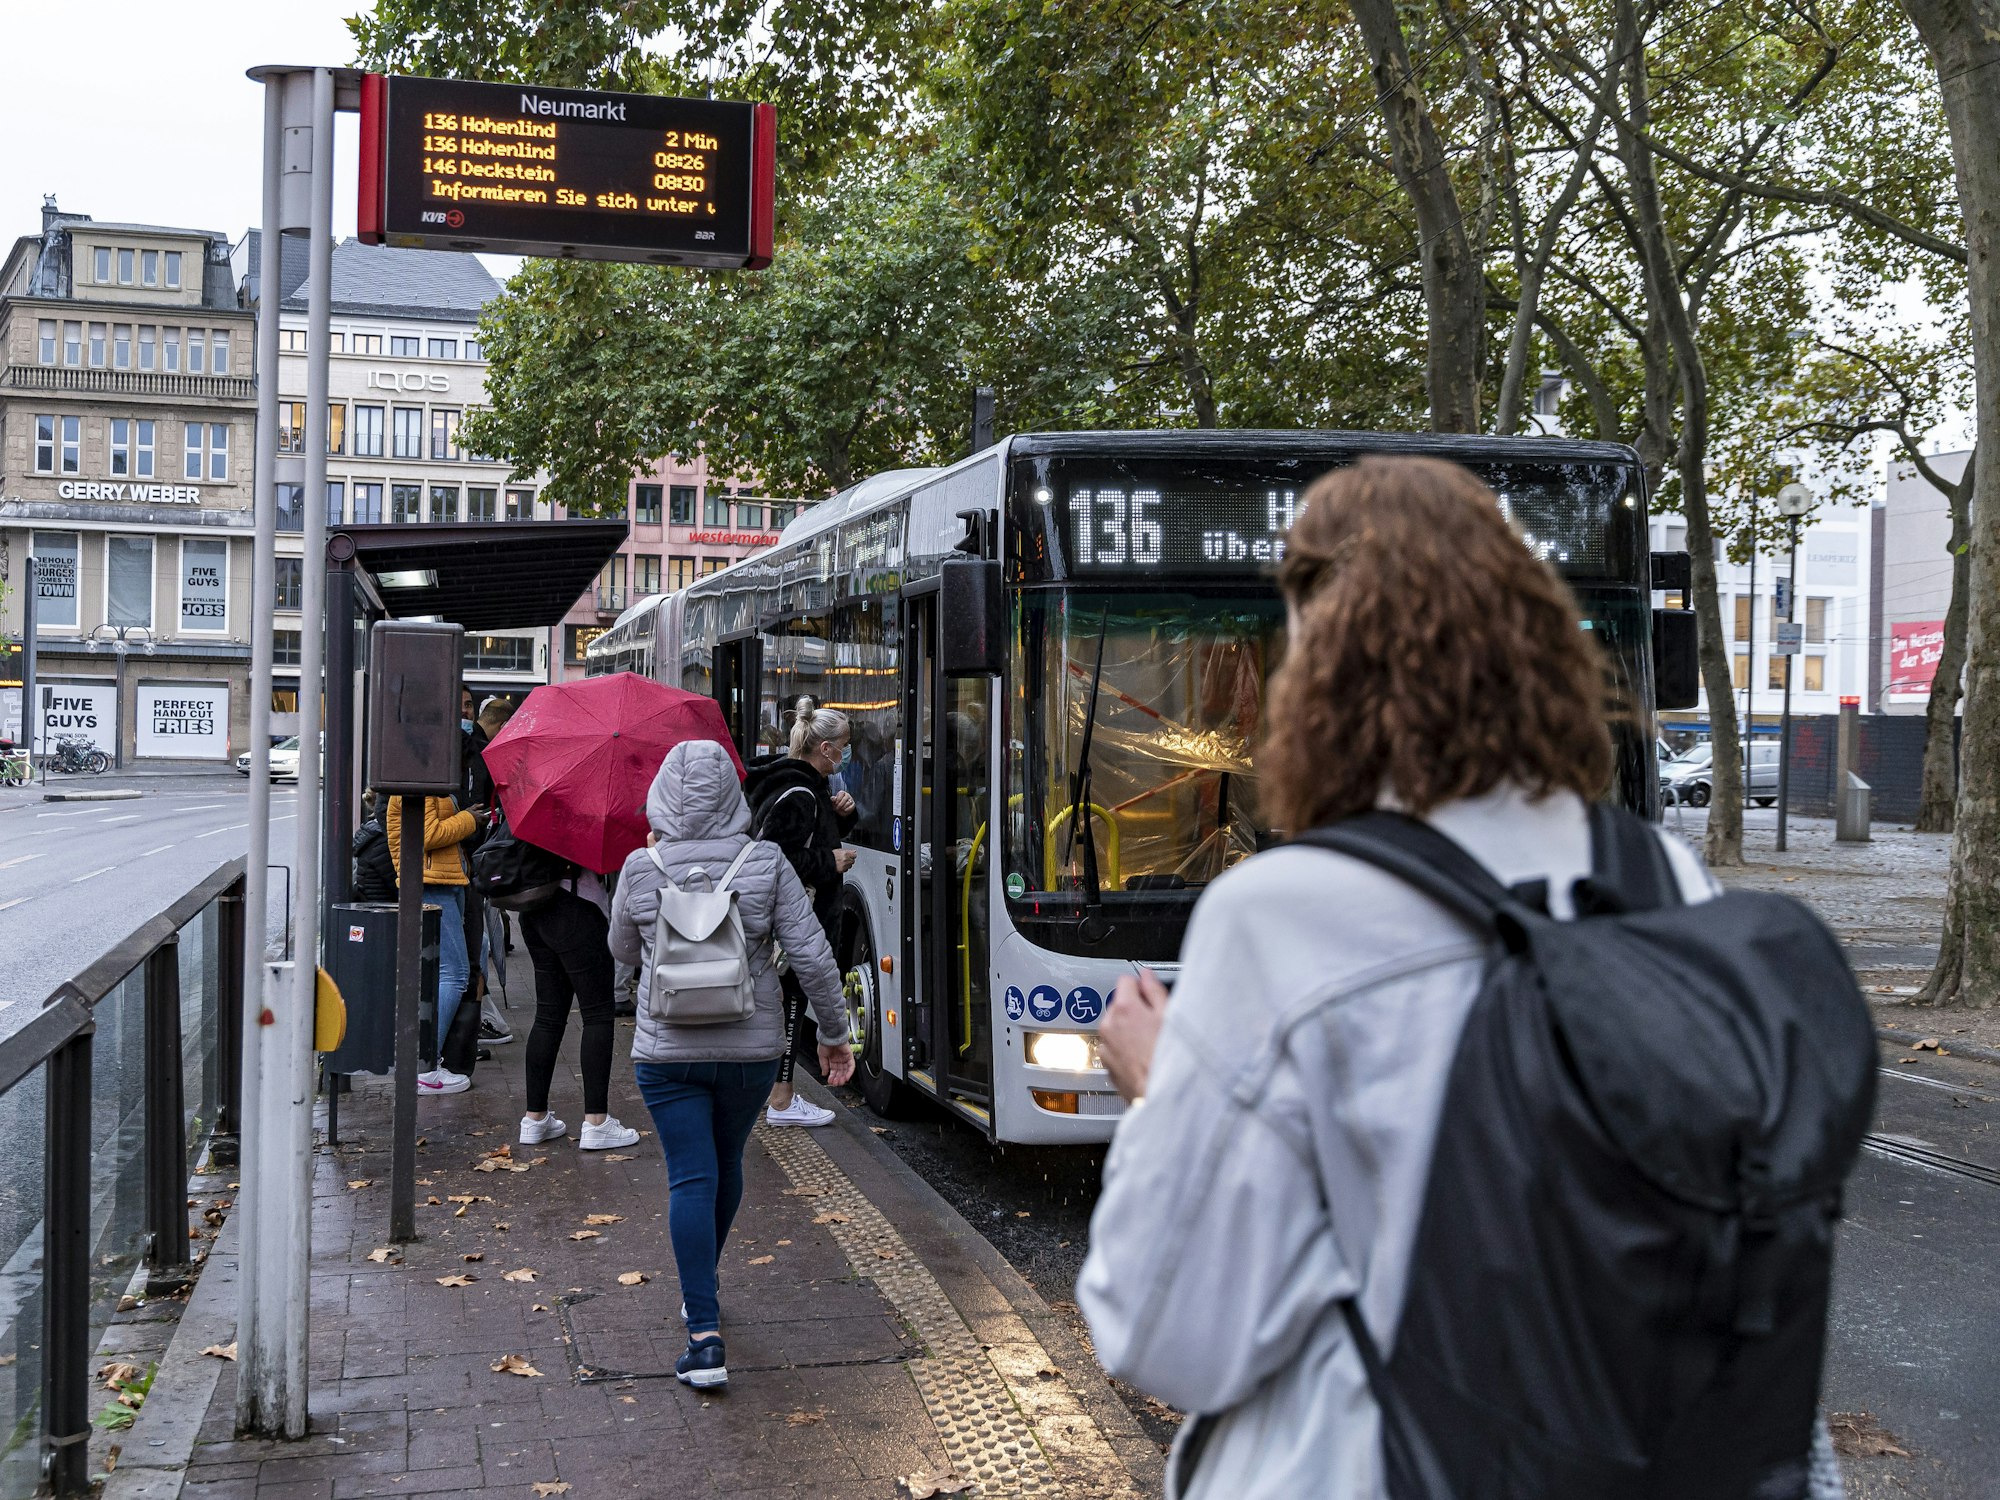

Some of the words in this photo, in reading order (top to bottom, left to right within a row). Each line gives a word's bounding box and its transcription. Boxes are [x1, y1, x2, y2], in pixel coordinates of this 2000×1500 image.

[520, 94, 627, 121] Neumarkt
[424, 112, 458, 132] 136
[461, 115, 556, 139] Hohenlind
[666, 131, 679, 147] 2
[684, 132, 718, 150] Min
[424, 135, 458, 154] 136
[461, 138, 556, 160] Hohenlind
[654, 152, 705, 171] 08:26
[423, 157, 457, 175] 146
[460, 160, 555, 182] Deckstein
[654, 173, 705, 192] 08:30
[432, 180, 547, 203] Informieren
[556, 189, 587, 206] Sie
[596, 192, 638, 210] sich
[646, 196, 698, 213] unter
[421, 211, 447, 224] KVB
[367, 370, 450, 393] IQOS
[58, 481, 127, 501] GERRY
[129, 484, 200, 505] WEBER
[1069, 490, 1161, 563] 136
[689, 531, 778, 545] westermann
[1203, 531, 1286, 560] über
[192, 567, 217, 576] FIVE
[188, 577, 219, 587] GUYS
[38, 583, 74, 597] TOWN
[183, 603, 224, 616] JOBS
[52, 697, 93, 711] FIVE
[153, 699, 214, 710] PERFECT
[153, 709, 186, 717] HAND
[190, 710, 214, 718] CUT
[46, 714, 97, 728] GUYS
[154, 718, 213, 735] FRIES
[1011, 875, 1018, 885] 4
